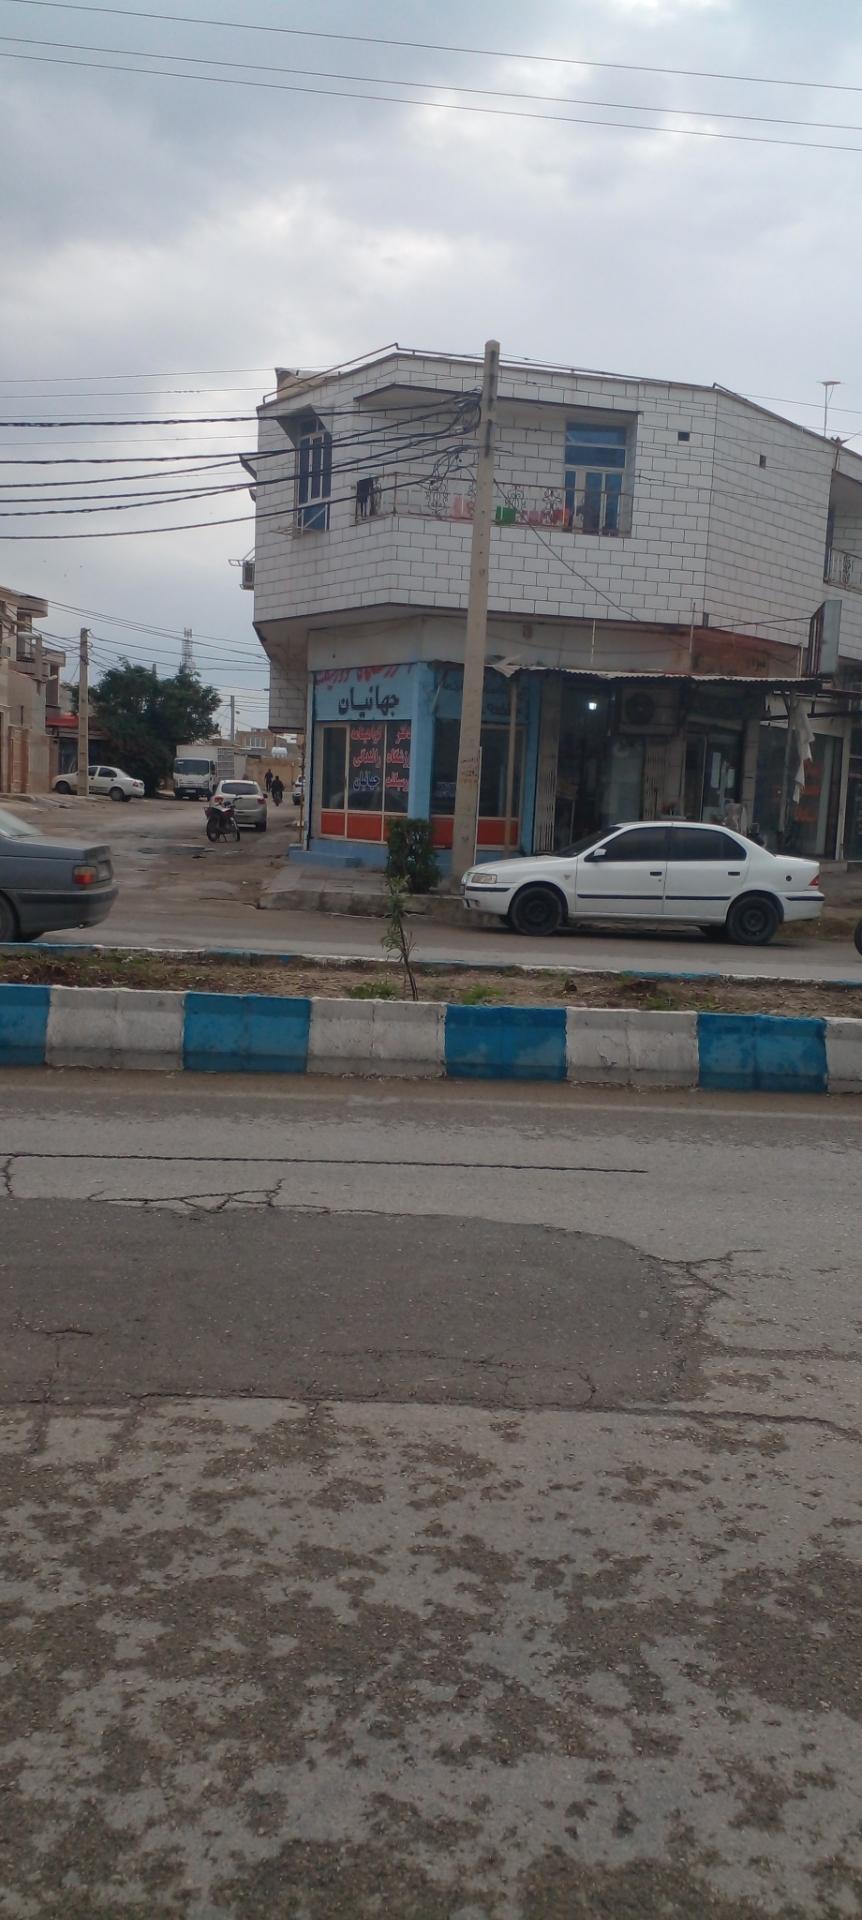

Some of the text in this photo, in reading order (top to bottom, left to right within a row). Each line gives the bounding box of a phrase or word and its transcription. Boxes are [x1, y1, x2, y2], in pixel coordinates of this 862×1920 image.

[338, 684, 400, 718] جهانیان
[352, 748, 382, 768] رانندگی
[352, 770, 381, 791] جهانیان
